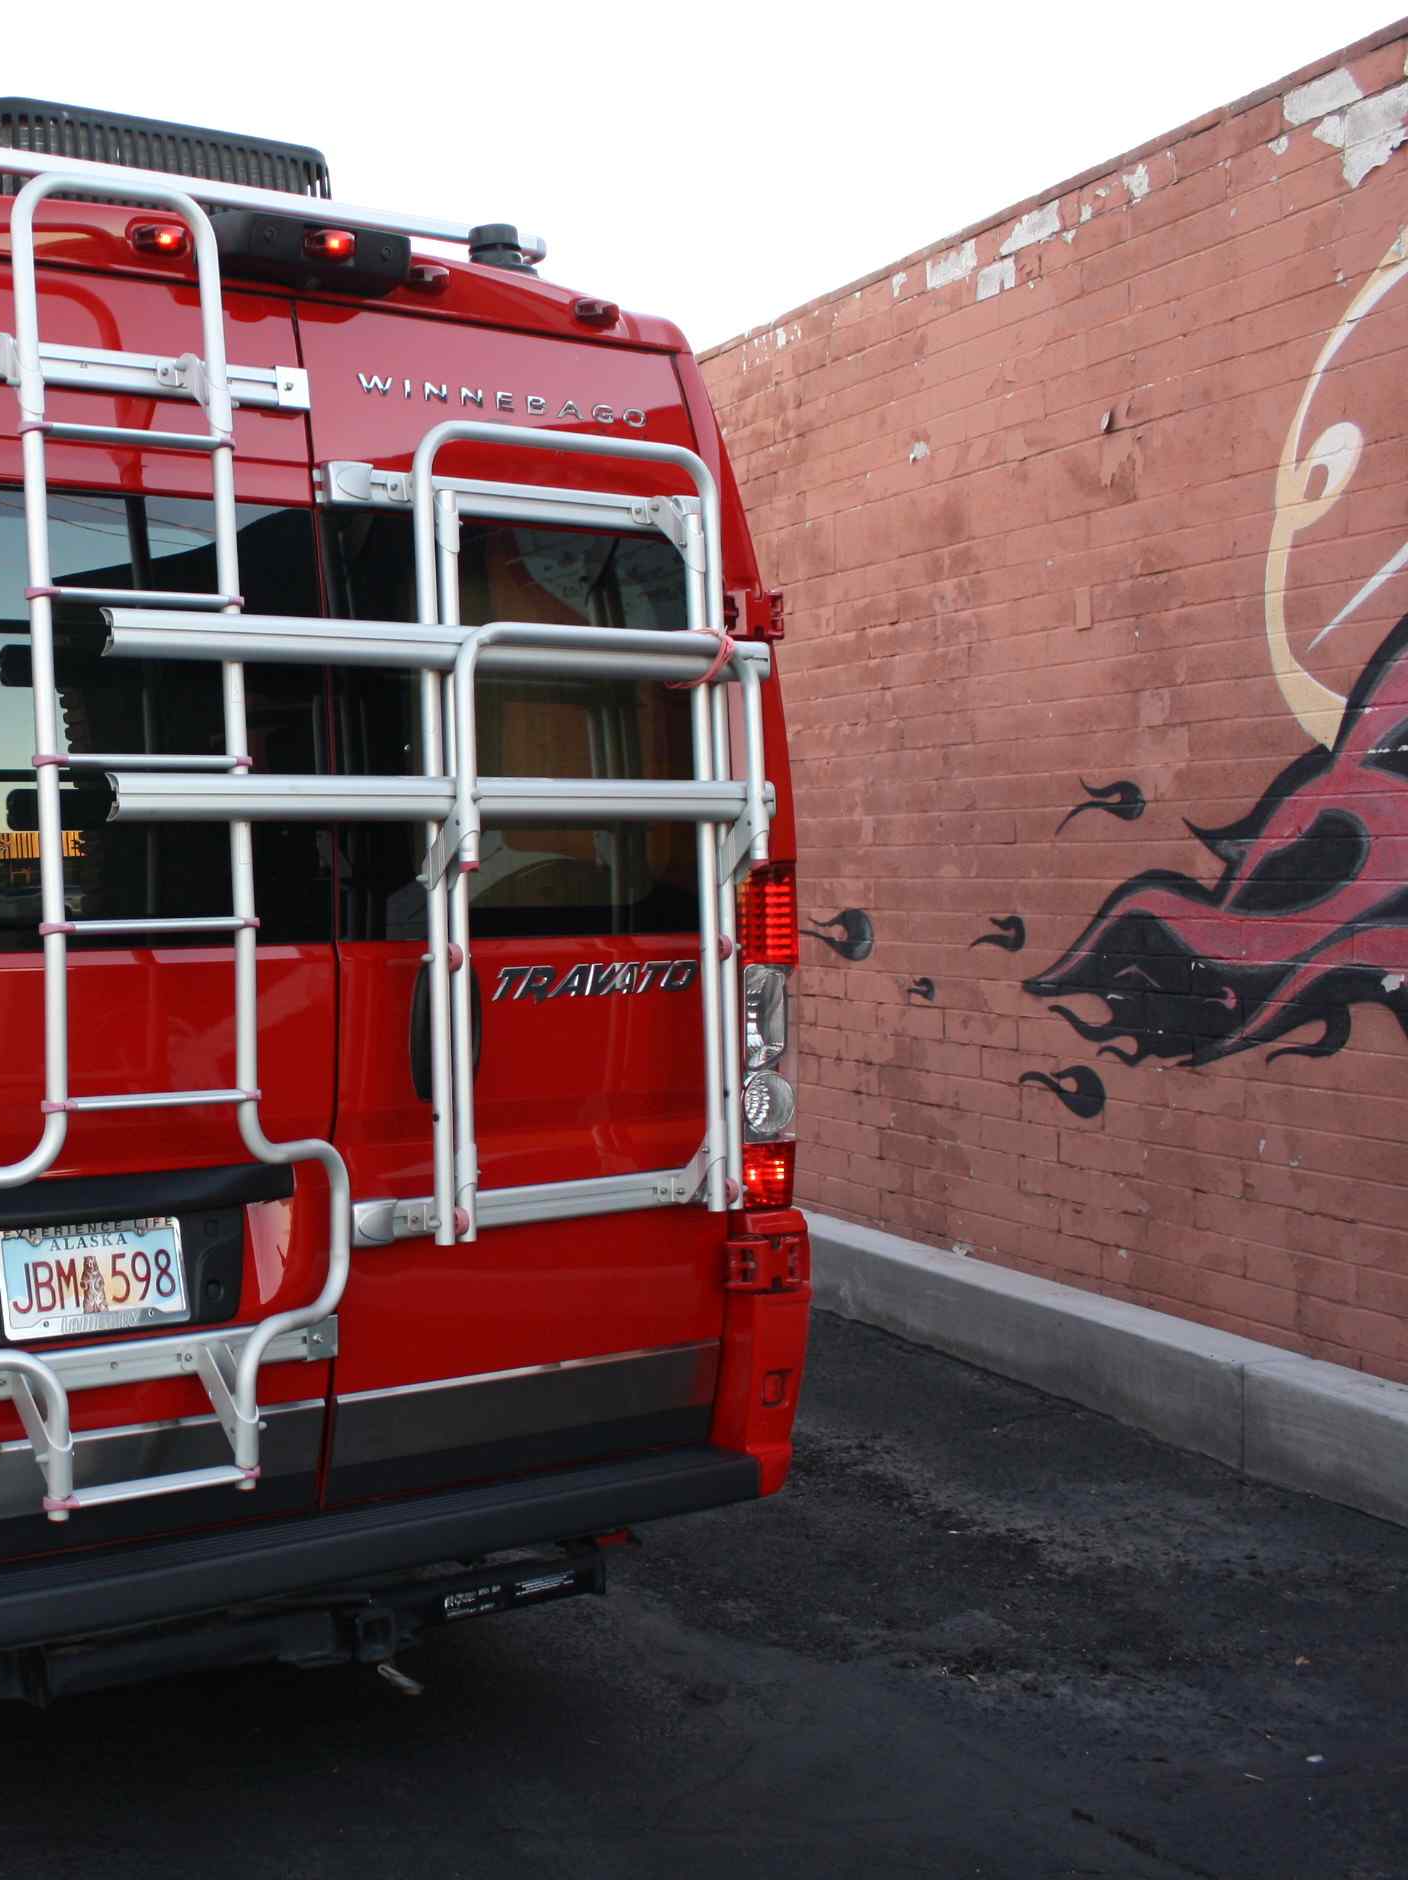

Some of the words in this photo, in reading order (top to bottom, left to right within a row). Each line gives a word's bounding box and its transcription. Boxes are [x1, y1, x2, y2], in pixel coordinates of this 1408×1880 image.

[357, 372, 648, 428] WINNEBAGO
[491, 959, 698, 1003] TRAVATO
[3, 1221, 122, 1239] EXPERIENCE
[49, 1232, 129, 1252] ALASKA
[12, 1257, 81, 1314] JBM
[110, 1248, 177, 1304] 598
